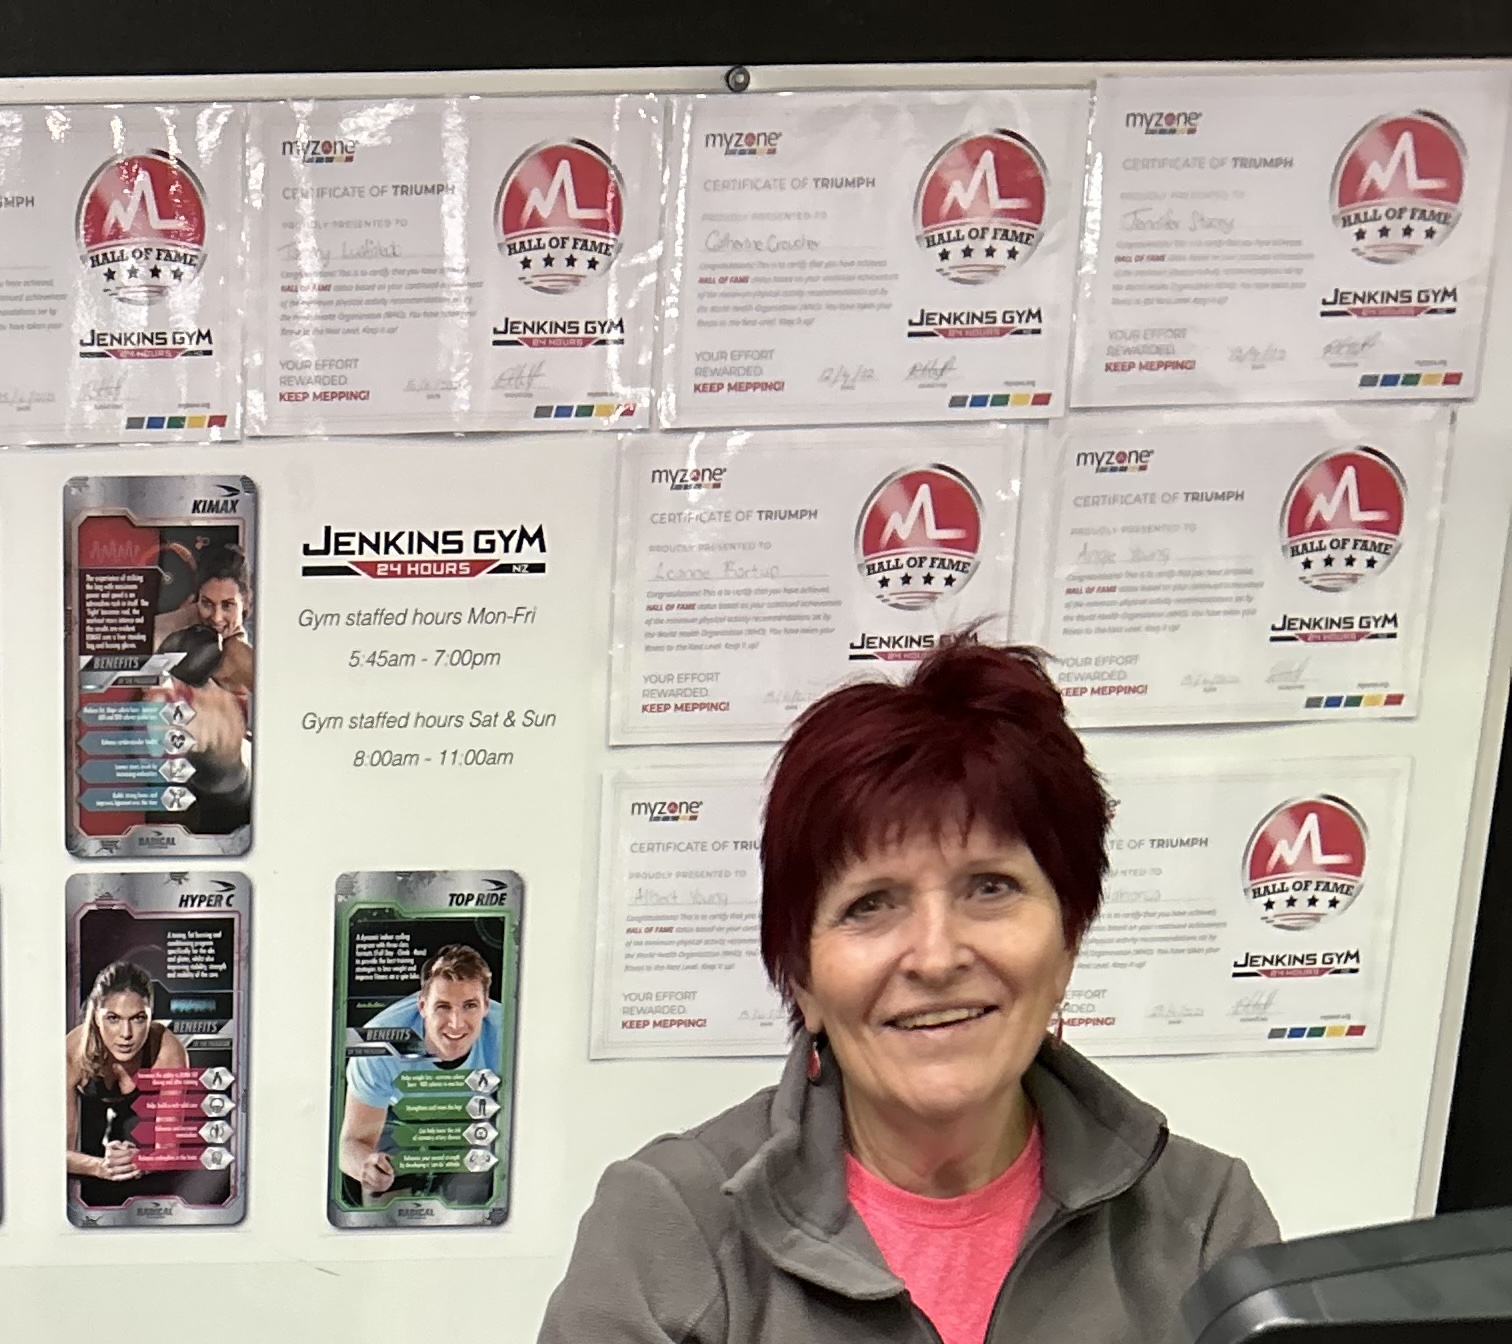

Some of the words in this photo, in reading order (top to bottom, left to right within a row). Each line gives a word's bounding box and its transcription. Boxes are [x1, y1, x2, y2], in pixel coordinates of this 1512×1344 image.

[1125, 111, 1202, 130] myzone
[705, 131, 782, 150] myzone
[704, 178, 787, 192] CERTIFICATE
[790, 178, 809, 190] OF
[813, 176, 876, 190] TRIUMPH
[1342, 209, 1381, 227] HALL
[1385, 207, 1407, 220] OF
[1409, 207, 1452, 226] FAME
[927, 228, 964, 247] HALL
[968, 227, 990, 240] OF
[992, 228, 1035, 247] FAME
[507, 238, 545, 257] HALL
[548, 237, 570, 249] OF
[573, 238, 615, 257] FAME
[90, 250, 126, 267] HALL
[132, 248, 153, 260] OF
[156, 249, 198, 266] FAME
[1321, 289, 1412, 305] JENKINS
[1417, 287, 1458, 304] GYM
[908, 309, 997, 326] JENKINS
[1002, 308, 1042, 324] GYM
[492, 318, 580, 335] JENKINS
[584, 318, 624, 334] GYM
[79, 329, 167, 347] JENKINS
[171, 329, 213, 345] GYM
[695, 351, 728, 362] YOUR
[730, 349, 774, 361] EFFORT
[279, 360, 312, 371] YOUR
[315, 359, 359, 370] EFFORT
[694, 382, 724, 393] KEEP
[728, 381, 785, 392] MEPPING!
[279, 392, 309, 402] KEEP
[312, 390, 369, 401] MEPPING!
[1076, 449, 1154, 469] myzone
[651, 467, 727, 488] myzone
[191, 500, 239, 514] KIMAX
[1074, 493, 1157, 507] CERTIFICATE
[1160, 492, 1180, 504] OF
[1183, 490, 1244, 503] TRIUMPH
[650, 511, 732, 524] CERTIFICATE
[734, 510, 753, 522] OF
[757, 509, 818, 522] TRIUMPH
[302, 525, 463, 555] JENKINS
[473, 524, 547, 553] GYM
[1291, 539, 1327, 556] HALL
[1330, 538, 1350, 550] OF
[1352, 539, 1393, 555] FAME
[376, 564, 401, 575] 24
[407, 563, 471, 575] HOURS
[512, 564, 529, 573] NZ
[866, 559, 905, 576] HALL
[907, 557, 926, 568] OF
[928, 558, 971, 575] FAME
[298, 609, 340, 630] Gym
[346, 608, 407, 626] staffed
[414, 608, 462, 626] hours
[467, 607, 537, 625] Mon-Fri
[1271, 614, 1355, 631] JENKINS
[1359, 613, 1398, 629] GYM
[848, 634, 936, 650] JENKINS
[93, 657, 140, 669] BENEFITS
[349, 650, 415, 667] 5:45am
[434, 650, 501, 668] 7:00pm
[643, 673, 675, 684] YOUR
[677, 672, 720, 682] EFFORT
[642, 703, 671, 713] KEEP
[674, 702, 729, 712] MEPPING!
[302, 713, 343, 734] Gym
[349, 712, 409, 730] staffed
[414, 712, 464, 728] hours
[469, 711, 499, 728] Sat
[503, 712, 516, 727] &
[522, 710, 556, 727] Sun
[353, 751, 419, 767] 8:00am
[439, 749, 513, 766] 11:00am
[631, 800, 703, 820] myzone
[1127, 839, 1145, 850] OF
[1149, 838, 1209, 849] TRIUMPH
[1251, 883, 1289, 898] HALL
[1292, 880, 1312, 892] OF
[1314, 882, 1355, 896] FAME
[179, 894, 223, 908] HYPER
[225, 894, 234, 907] C
[448, 893, 473, 906] TOP
[476, 893, 507, 906] RIDE
[1233, 952, 1317, 968] JENKINS
[1321, 950, 1360, 966] GYM
[622, 992, 653, 1001] YOUR
[655, 991, 697, 1001] EFFORT
[172, 1021, 218, 1033] BENEFITS
[621, 1020, 650, 1030] KEEP
[653, 1018, 707, 1029] MEPPING!
[366, 1028, 411, 1041] BENEFITS
